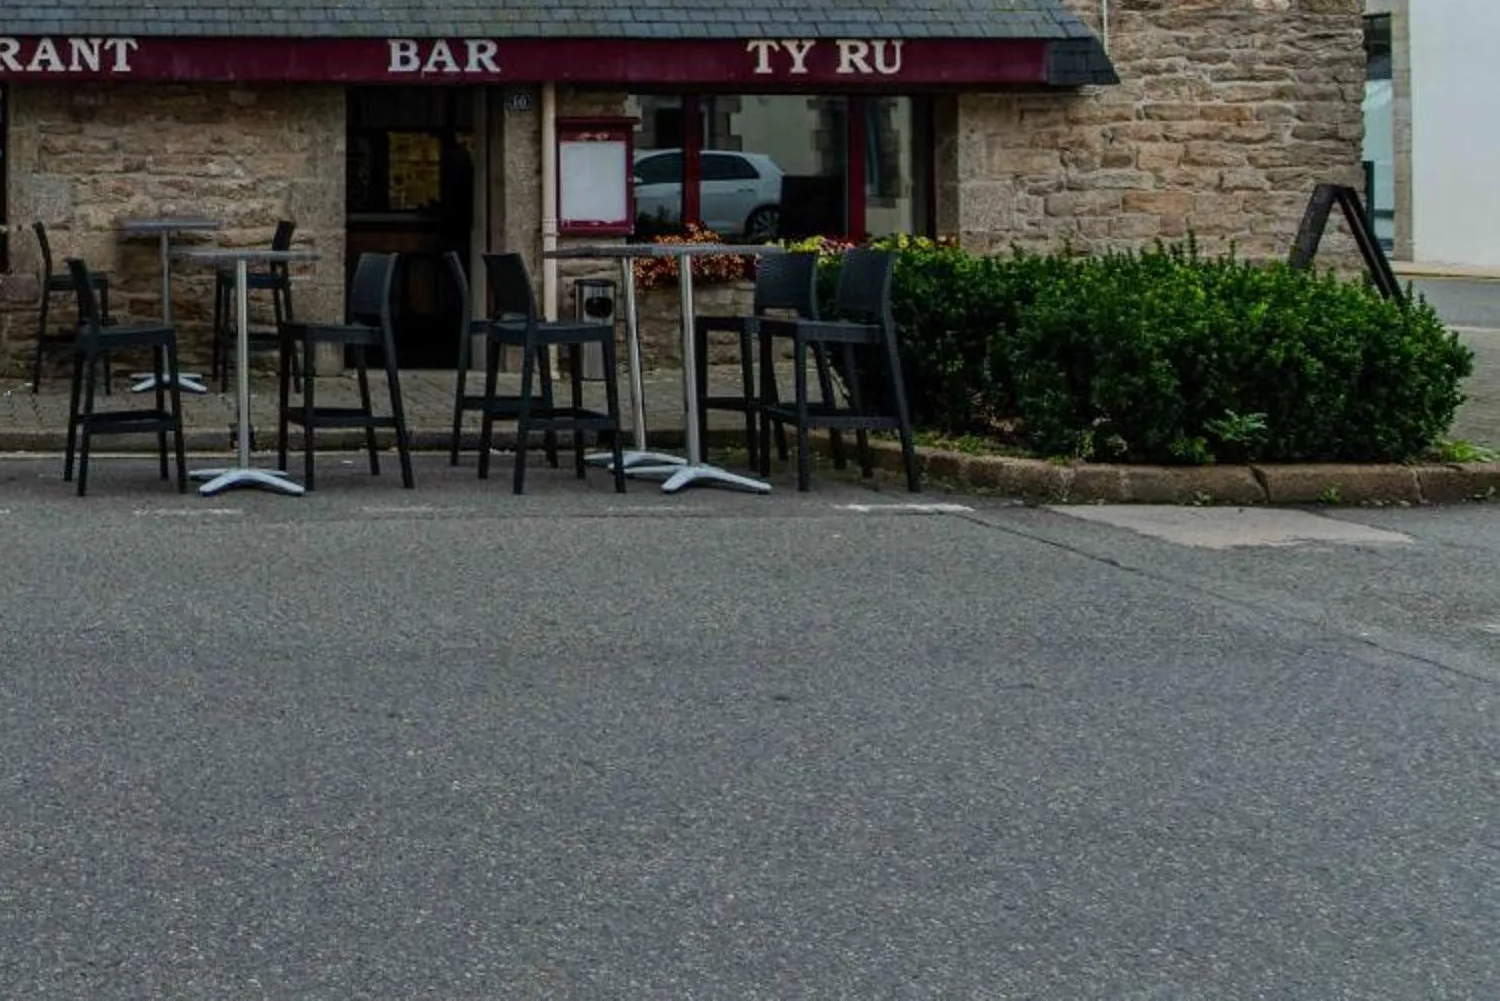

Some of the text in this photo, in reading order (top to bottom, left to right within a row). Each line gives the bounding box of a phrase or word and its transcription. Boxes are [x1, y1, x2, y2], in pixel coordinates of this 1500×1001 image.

[387, 38, 502, 73] BAR
[746, 39, 816, 74] TY
[835, 39, 904, 75] RU
